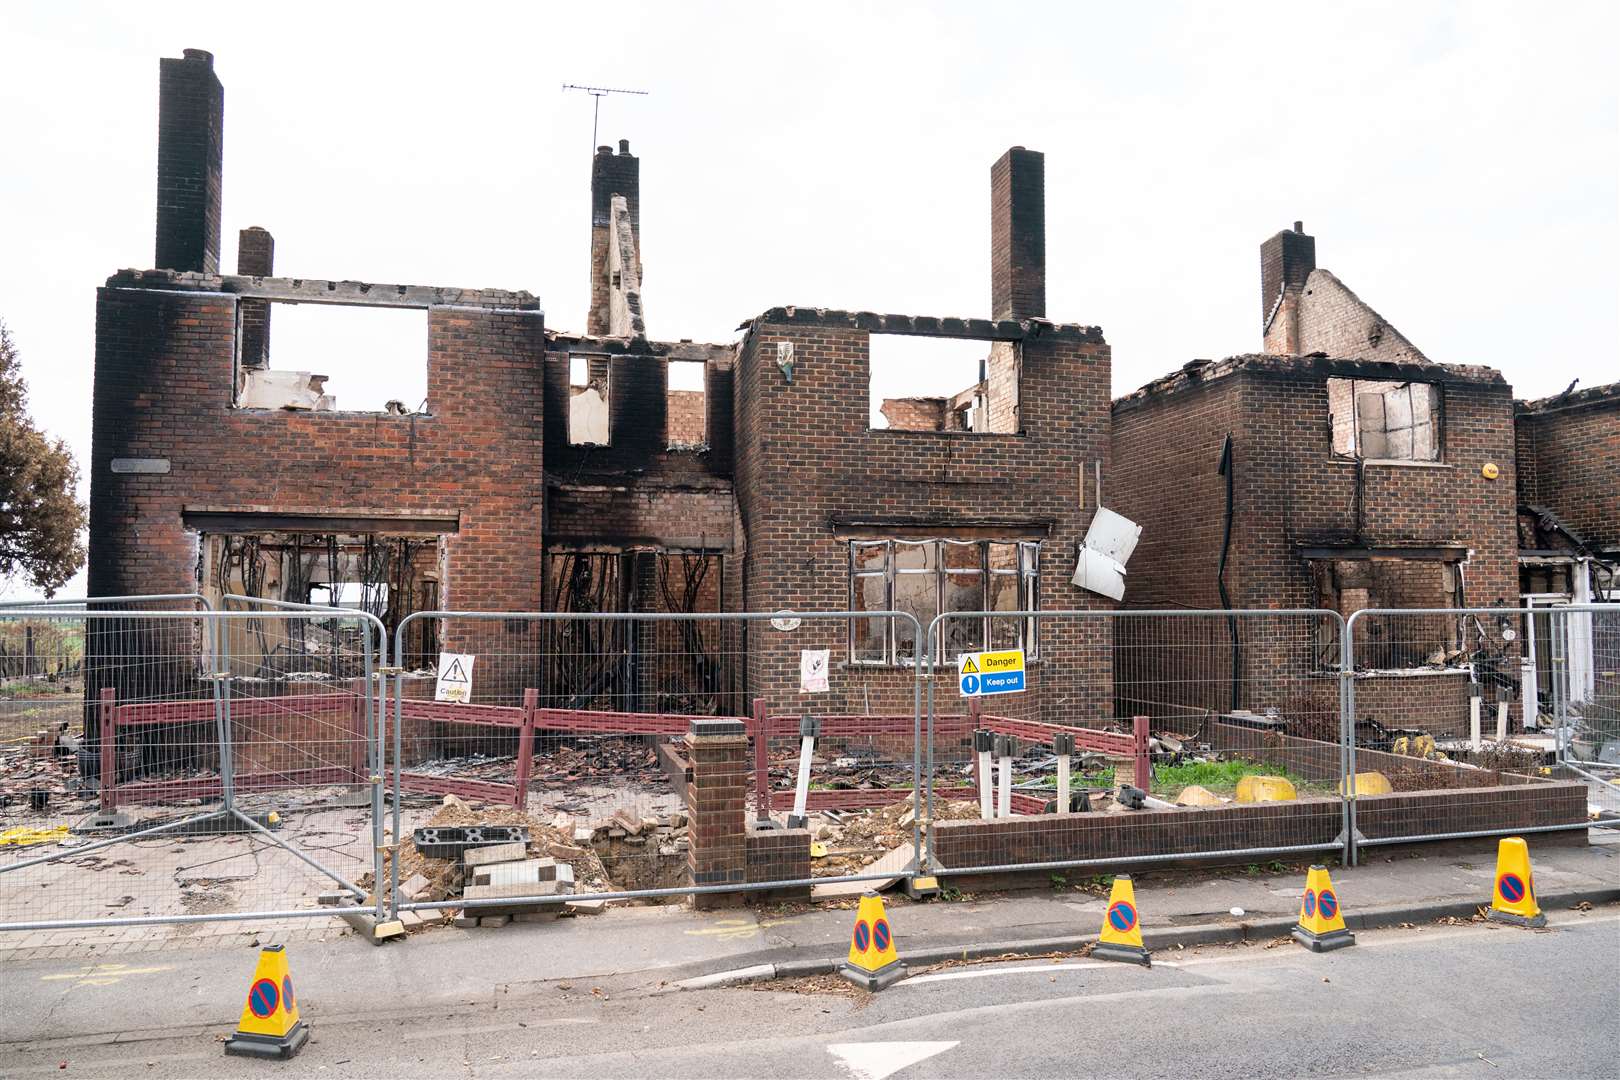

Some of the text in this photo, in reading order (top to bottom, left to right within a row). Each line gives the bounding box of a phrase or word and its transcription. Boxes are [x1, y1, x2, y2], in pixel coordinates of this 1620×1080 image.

[986, 658, 1016, 667] Danger
[986, 676, 1018, 687] Keep out
[440, 688, 467, 697] Caution
